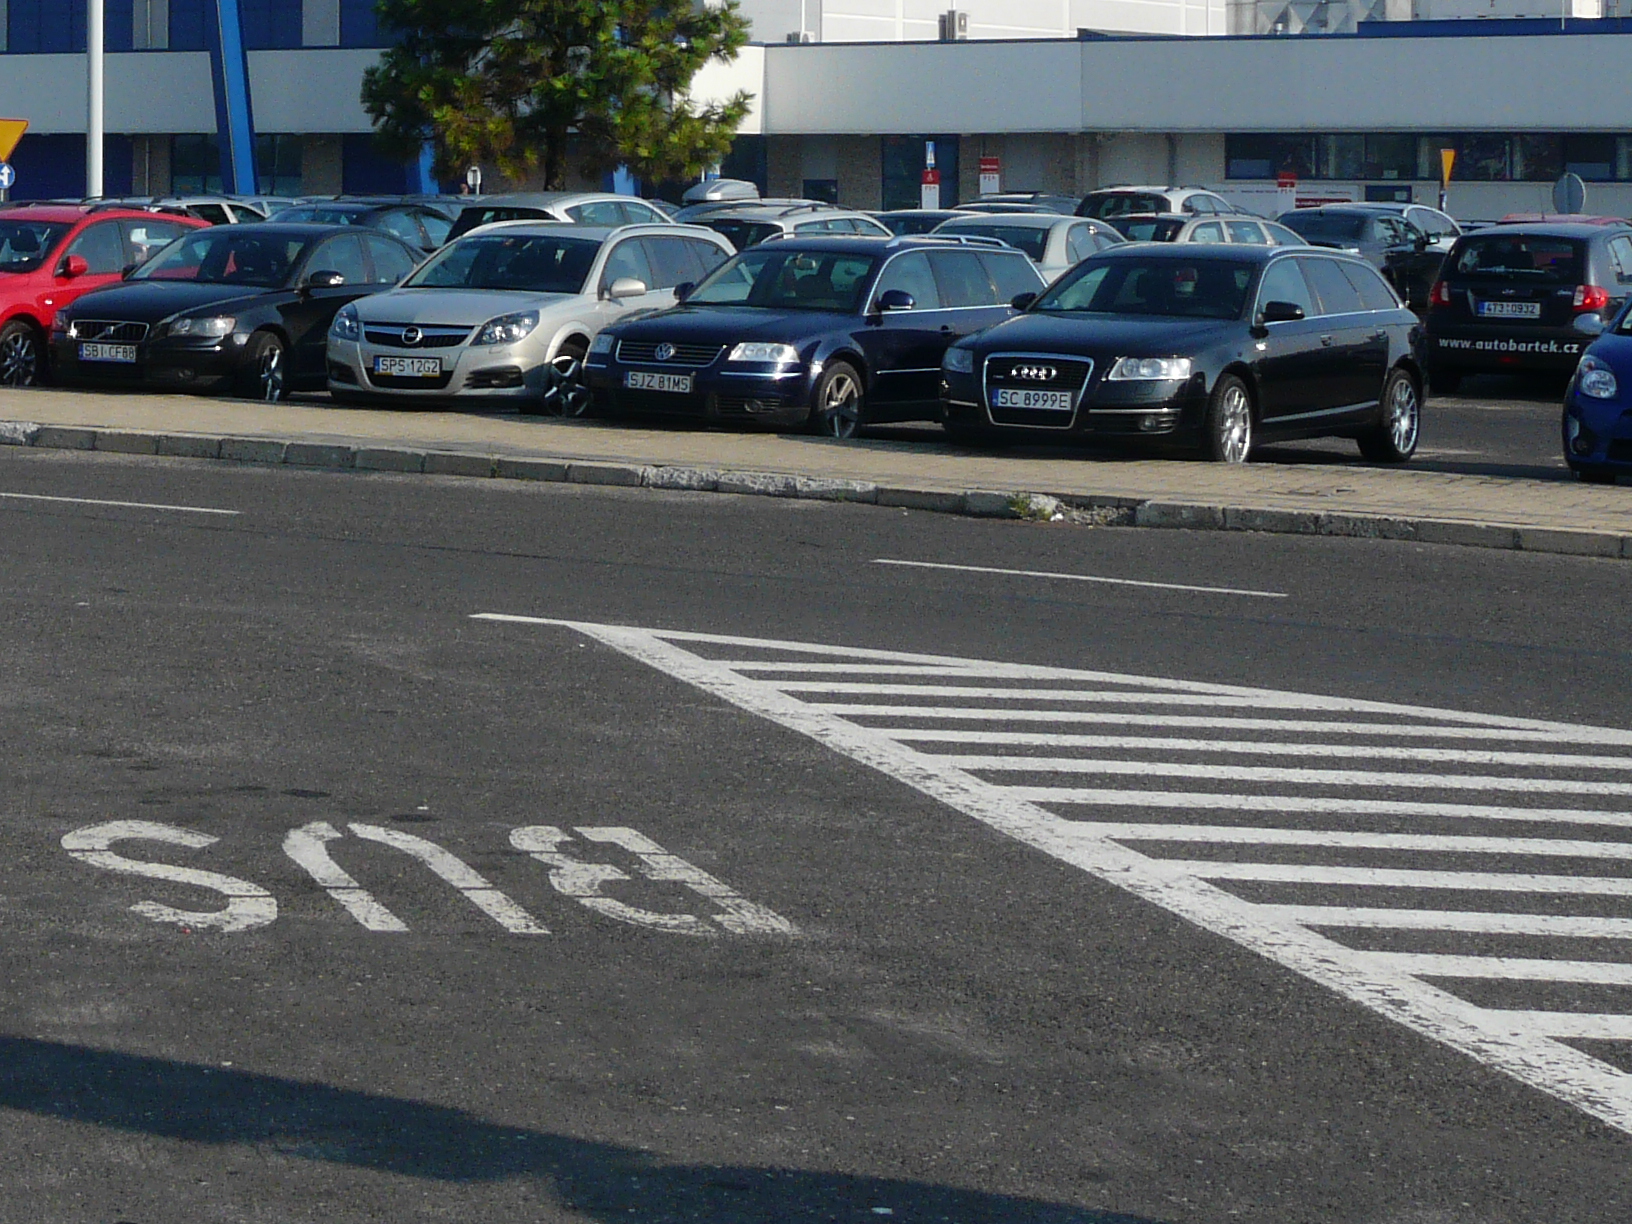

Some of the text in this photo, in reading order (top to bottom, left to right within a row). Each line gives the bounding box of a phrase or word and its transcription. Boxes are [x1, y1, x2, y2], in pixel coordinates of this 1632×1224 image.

[1438, 338, 1580, 354] www.autobartek.cz
[380, 358, 438, 374] SPS 12G2
[629, 372, 655, 389] SJZ
[999, 390, 1069, 409] SC 8999E
[60, 819, 802, 935] BUS
